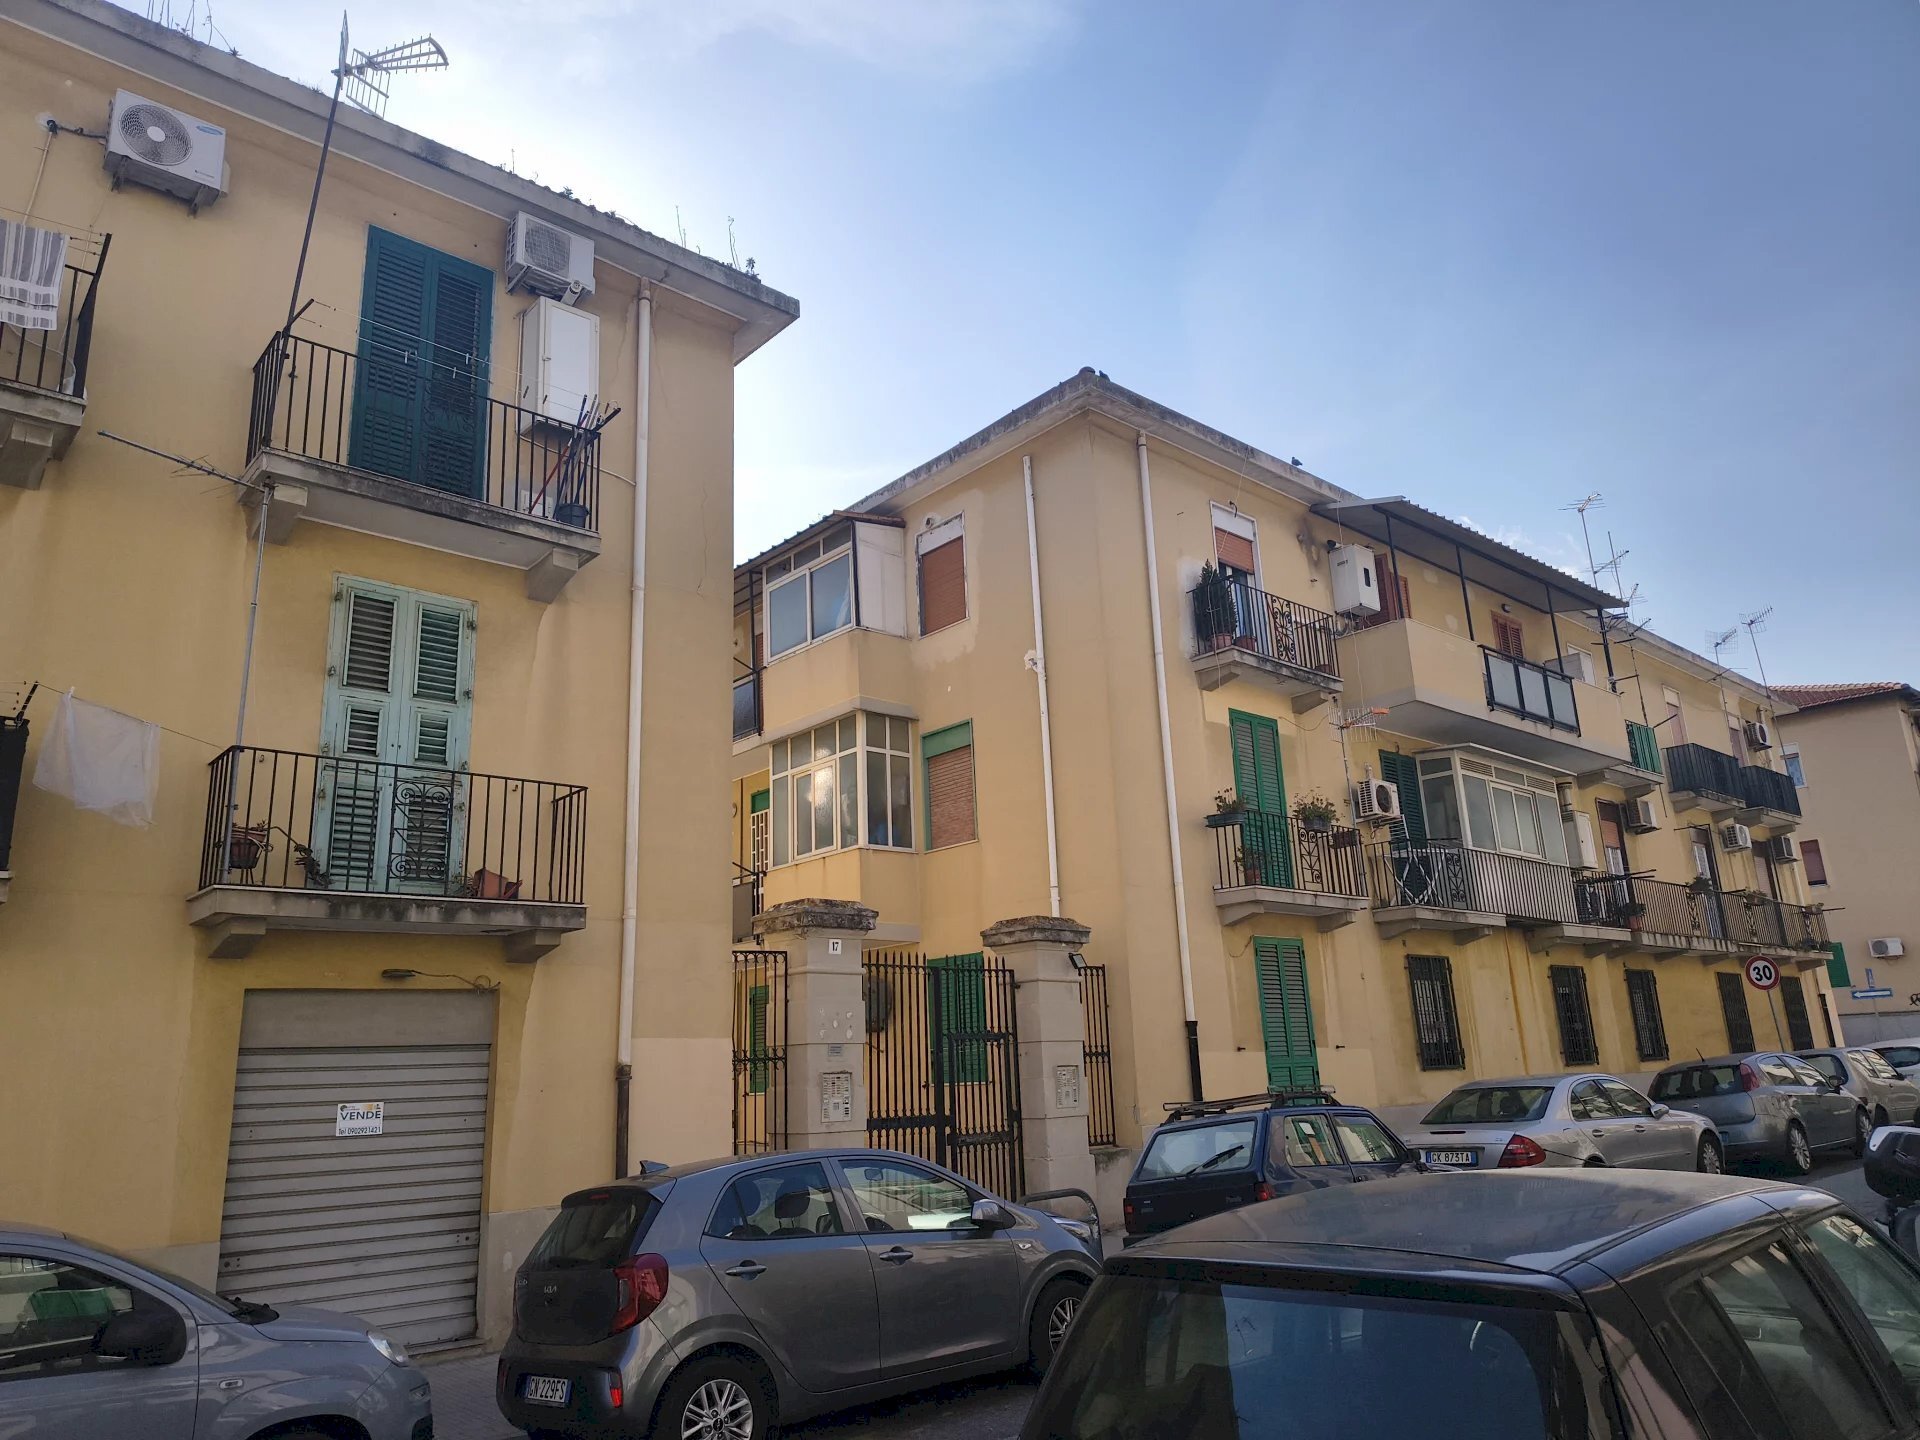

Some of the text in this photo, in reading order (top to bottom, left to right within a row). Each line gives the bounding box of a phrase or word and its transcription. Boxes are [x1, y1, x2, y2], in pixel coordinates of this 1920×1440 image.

[832, 941, 839, 952] 17
[1752, 964, 1773, 982] 30
[340, 1111, 381, 1120] VENDE
